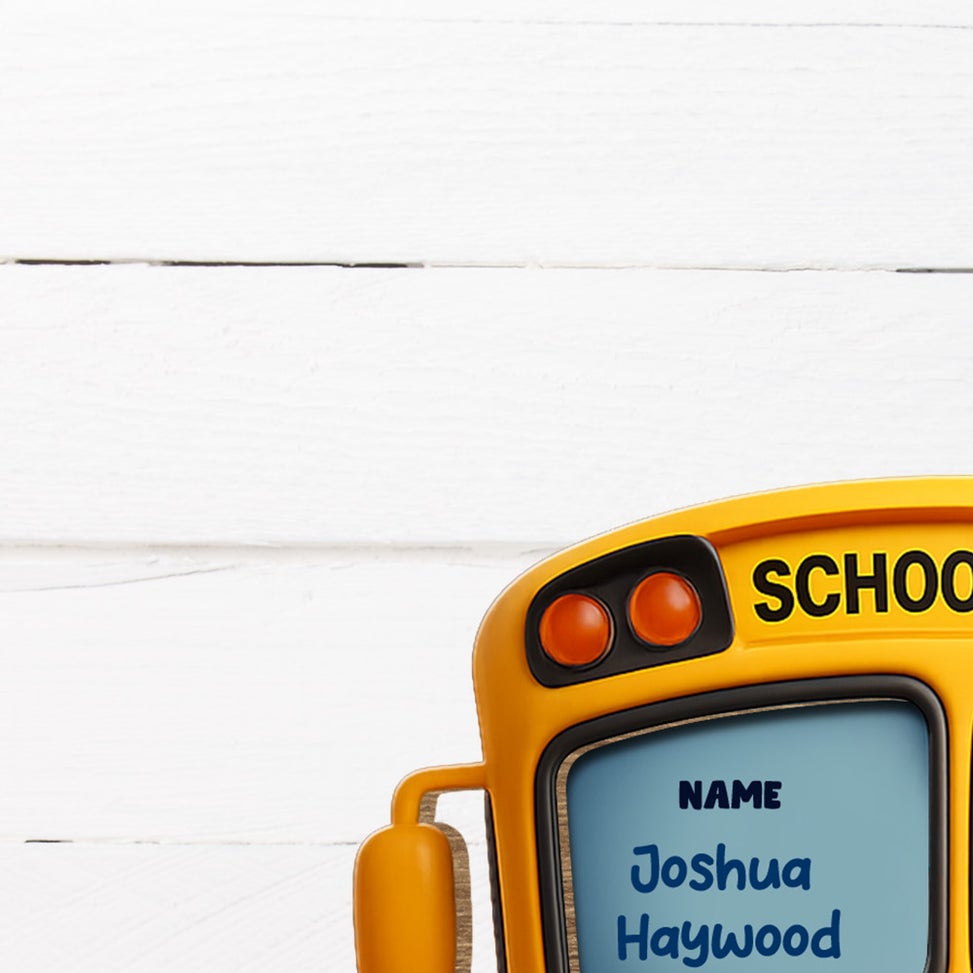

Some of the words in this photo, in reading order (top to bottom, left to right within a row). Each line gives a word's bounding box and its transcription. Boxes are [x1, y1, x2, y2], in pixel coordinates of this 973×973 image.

[678, 779, 783, 811] NAME
[629, 843, 812, 895] Joshua
[616, 908, 842, 968] Haywood
